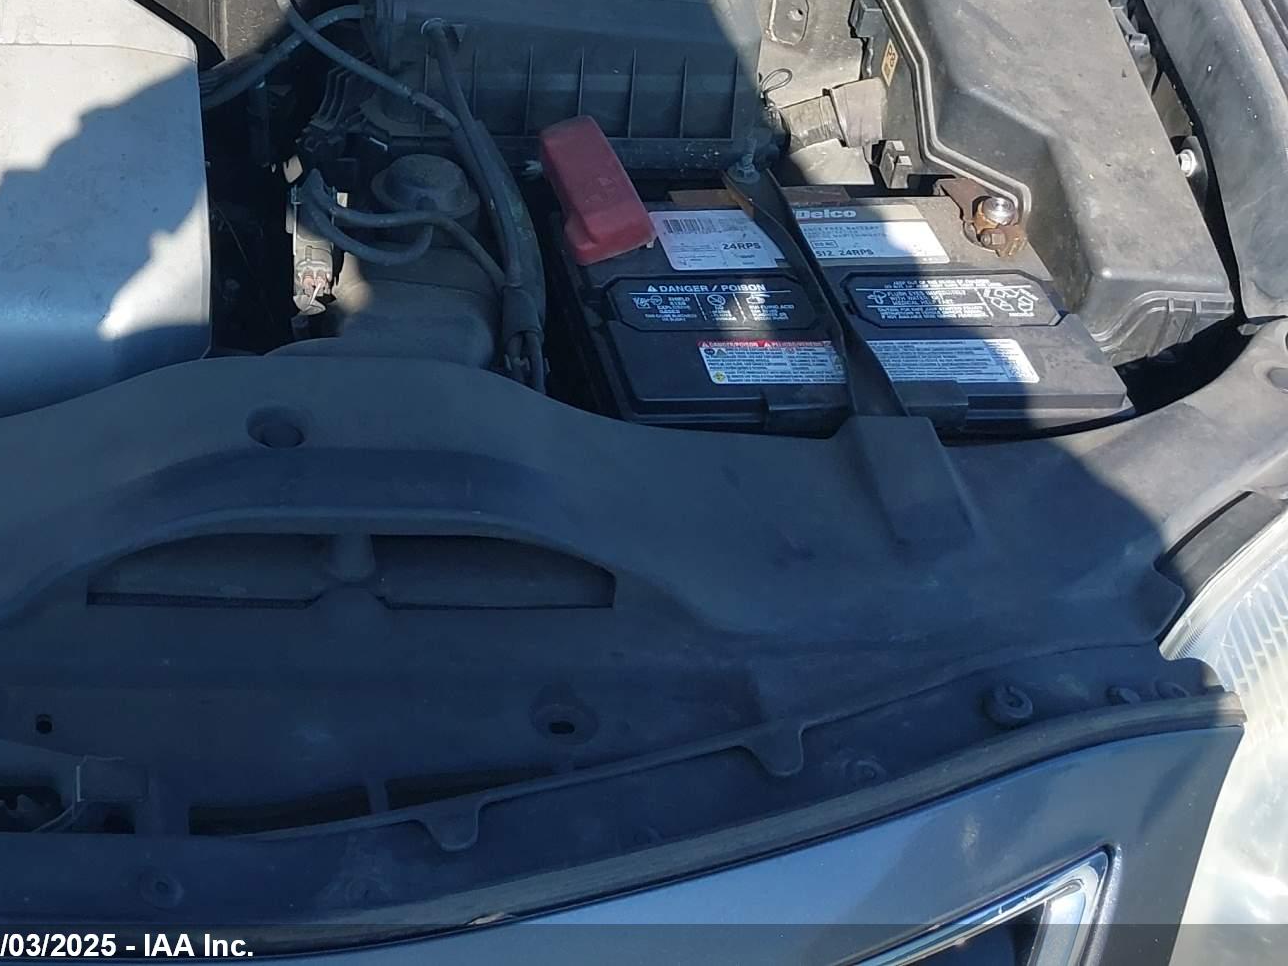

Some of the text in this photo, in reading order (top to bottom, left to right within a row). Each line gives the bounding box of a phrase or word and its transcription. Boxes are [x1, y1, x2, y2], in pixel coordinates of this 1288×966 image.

[722, 242, 762, 250] 24RPS
[839, 248, 875, 256] 24RPS
[658, 285, 709, 293] DANGER
[721, 284, 767, 292] POISON
